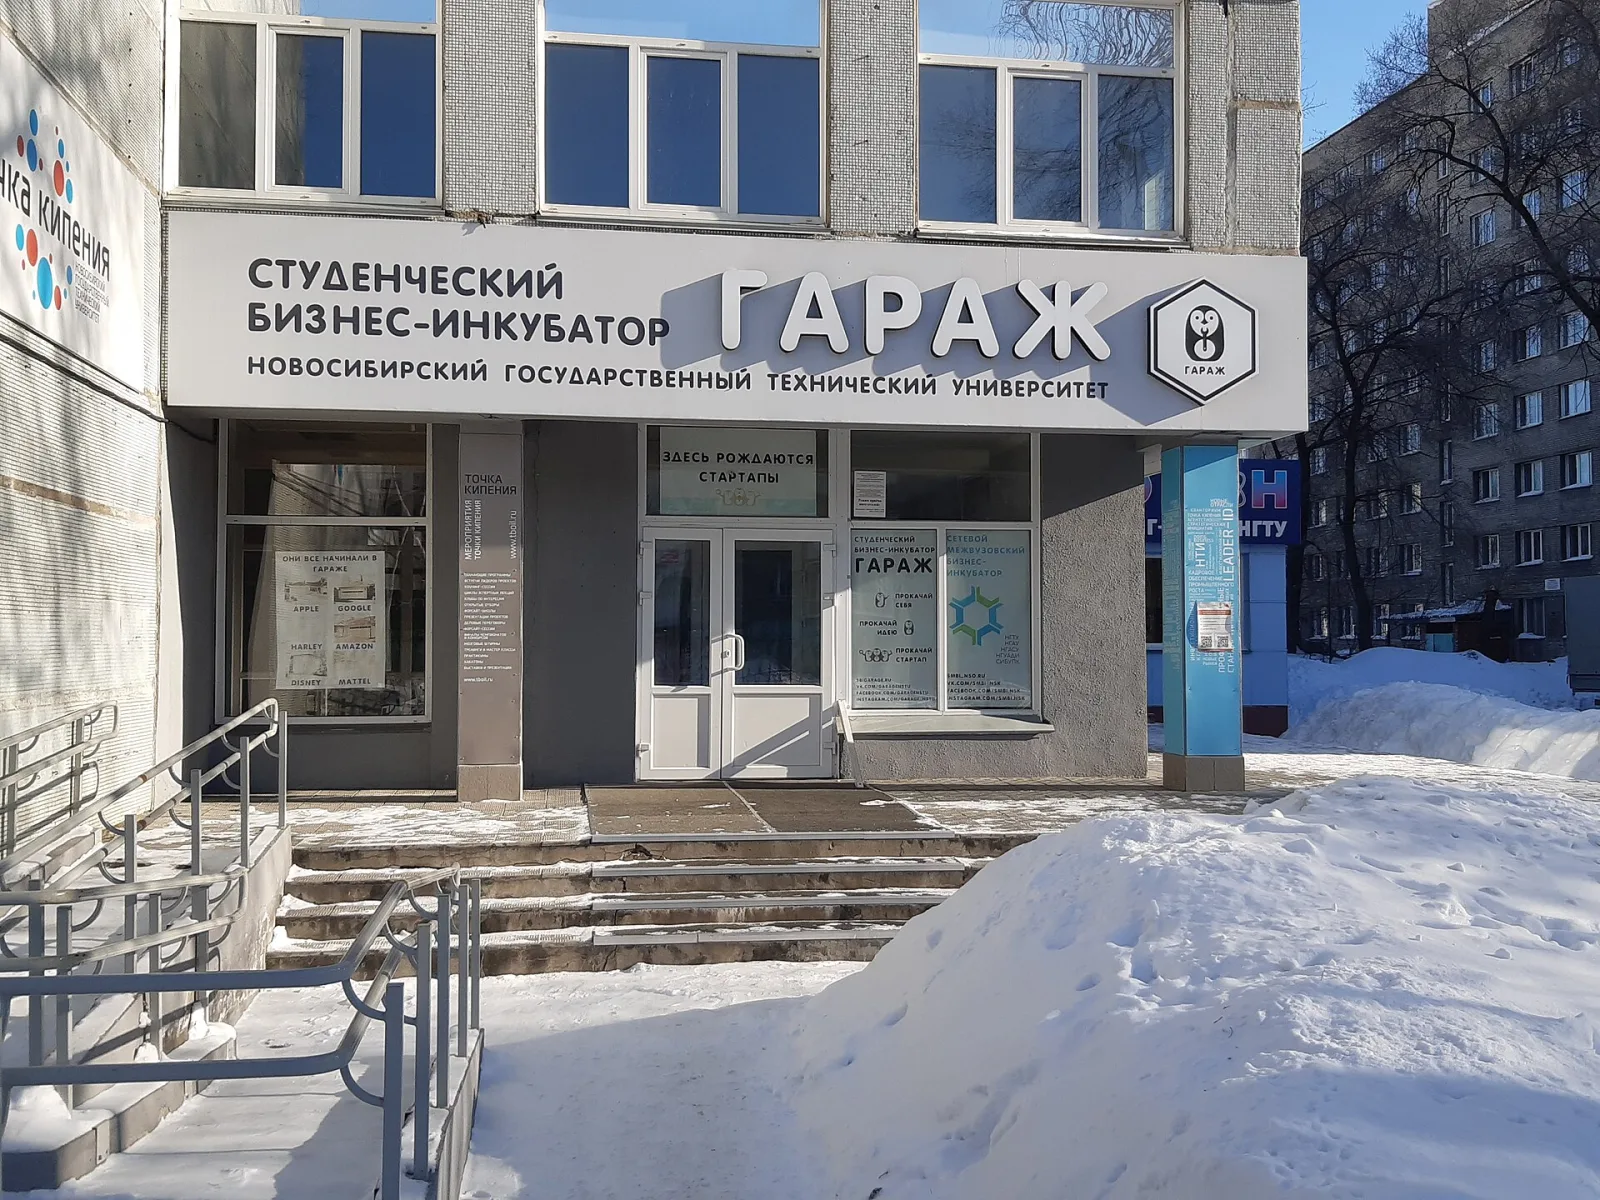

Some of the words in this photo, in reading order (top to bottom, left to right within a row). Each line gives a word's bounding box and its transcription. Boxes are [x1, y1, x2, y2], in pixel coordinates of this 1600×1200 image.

[39, 190, 110, 282] кипения
[247, 257, 563, 300] СТУДЕНЧЕСКИЙ
[247, 302, 670, 346] БИЗНЕС-ИНКУБАТОР
[720, 269, 1111, 361] ГАРАЖ
[247, 356, 488, 382] НОВОСИБИРСКИЙ
[505, 364, 752, 391] ГОСУДАРСТВЕННЫЙ
[767, 372, 937, 397] ТЕХНИЧЕСКИЙ
[953, 378, 1109, 400] УНИВЕРСИТЕТ
[1184, 366, 1226, 375] ГАРАЖ
[662, 451, 710, 463] ЗДЕСЬ
[716, 452, 814, 465] РОЖДАЮТСЯ
[464, 474, 503, 484] ТОЧКА
[699, 471, 779, 484] СТАРТАПЫ
[464, 485, 517, 495] КИПЕНИЯ
[464, 500, 472, 560] МЕРОПРИЯТИЯ
[508, 510, 517, 560] www.tboil.ru
[946, 534, 988, 542] СЕТЕВОЙ
[1239, 520, 1288, 538] НГТУ
[946, 546, 1025, 554] МЕЖВУЗОВСКИЙ
[1195, 542, 1206, 568] НТИ
[1222, 508, 1235, 582] LEADER-ID
[855, 557, 933, 574] ГАРАЖ
